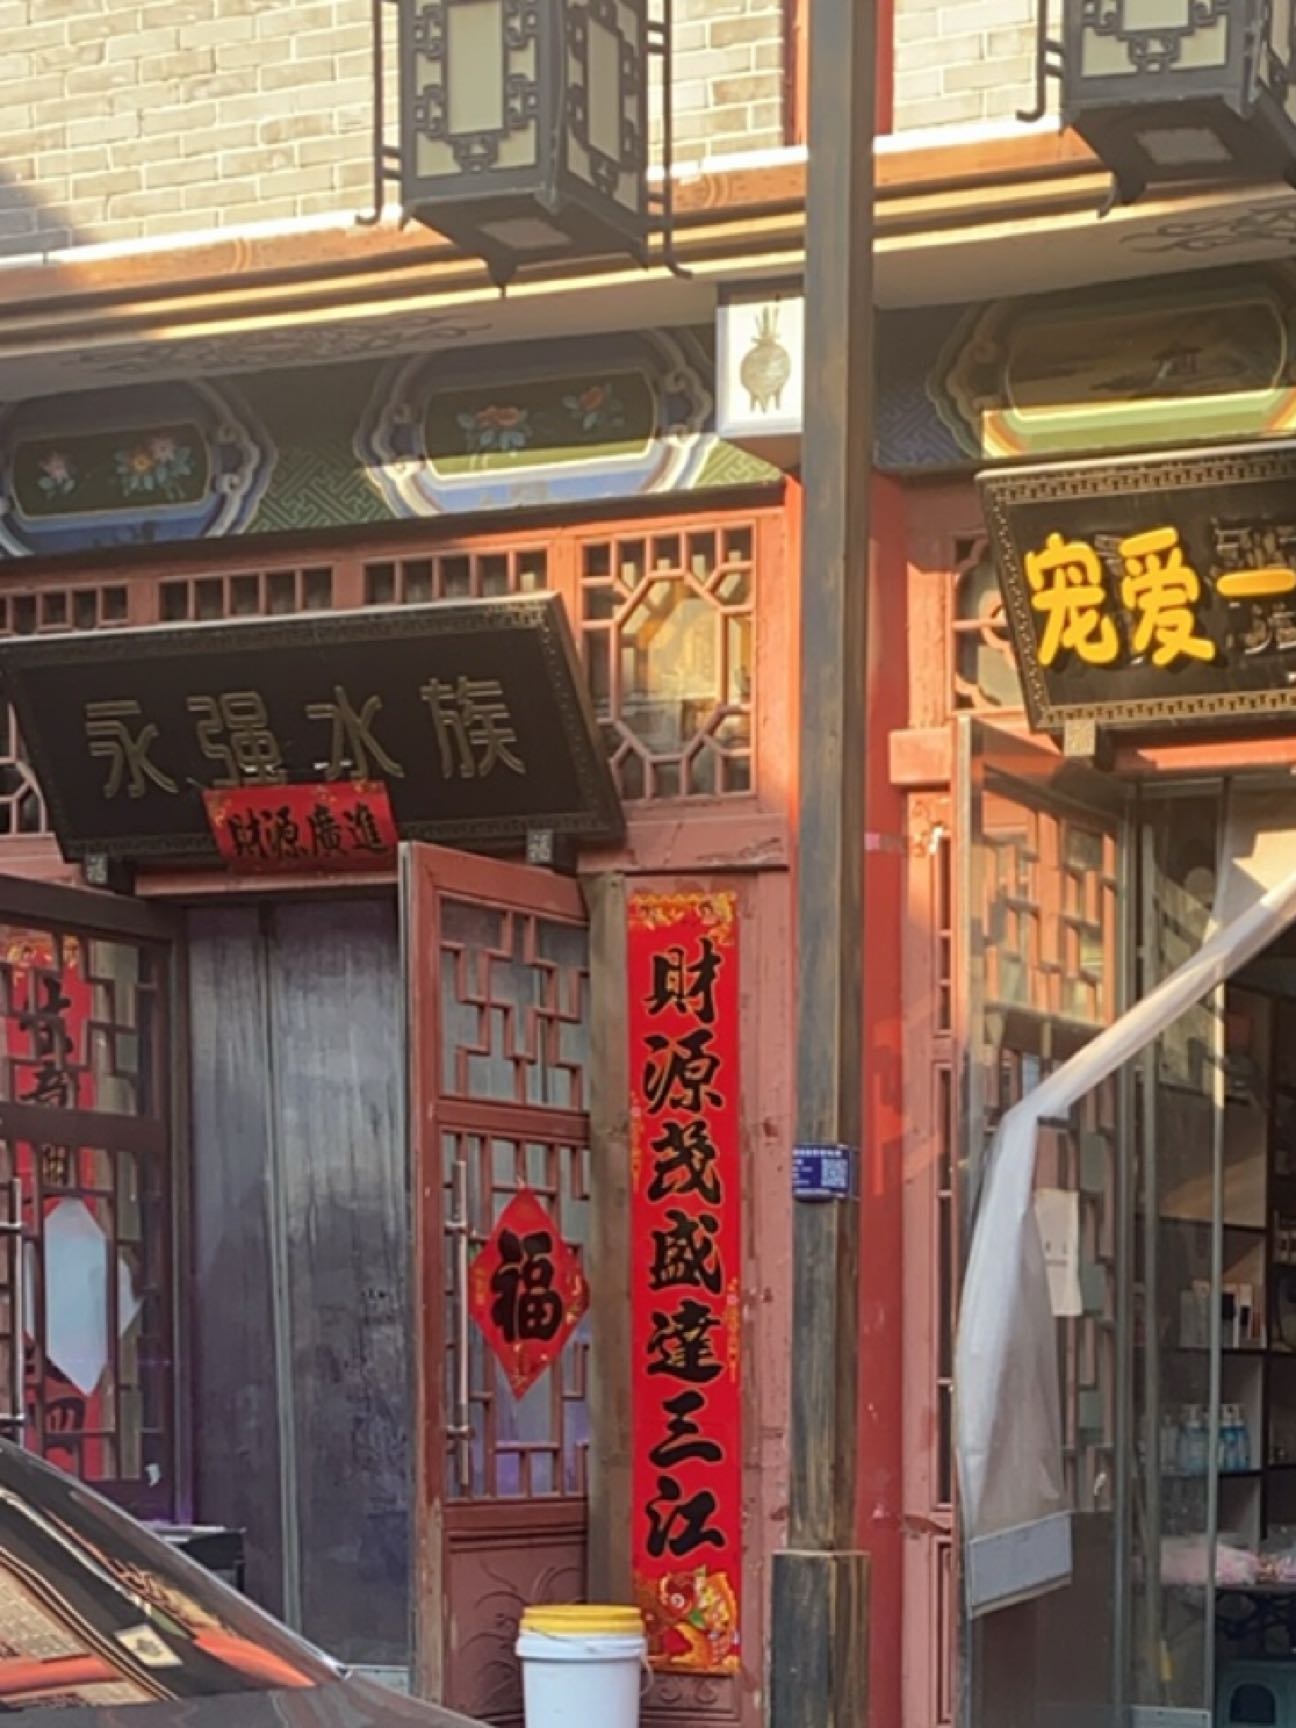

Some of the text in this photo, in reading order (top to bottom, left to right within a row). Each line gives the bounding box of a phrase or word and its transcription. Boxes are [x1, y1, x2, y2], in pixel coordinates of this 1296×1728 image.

[85, 676, 527, 798] 永强水族
[229, 803, 389, 857] 財源廣進
[490, 1230, 563, 1342] 福
[643, 937, 726, 1557] 財源茂盛達三江
